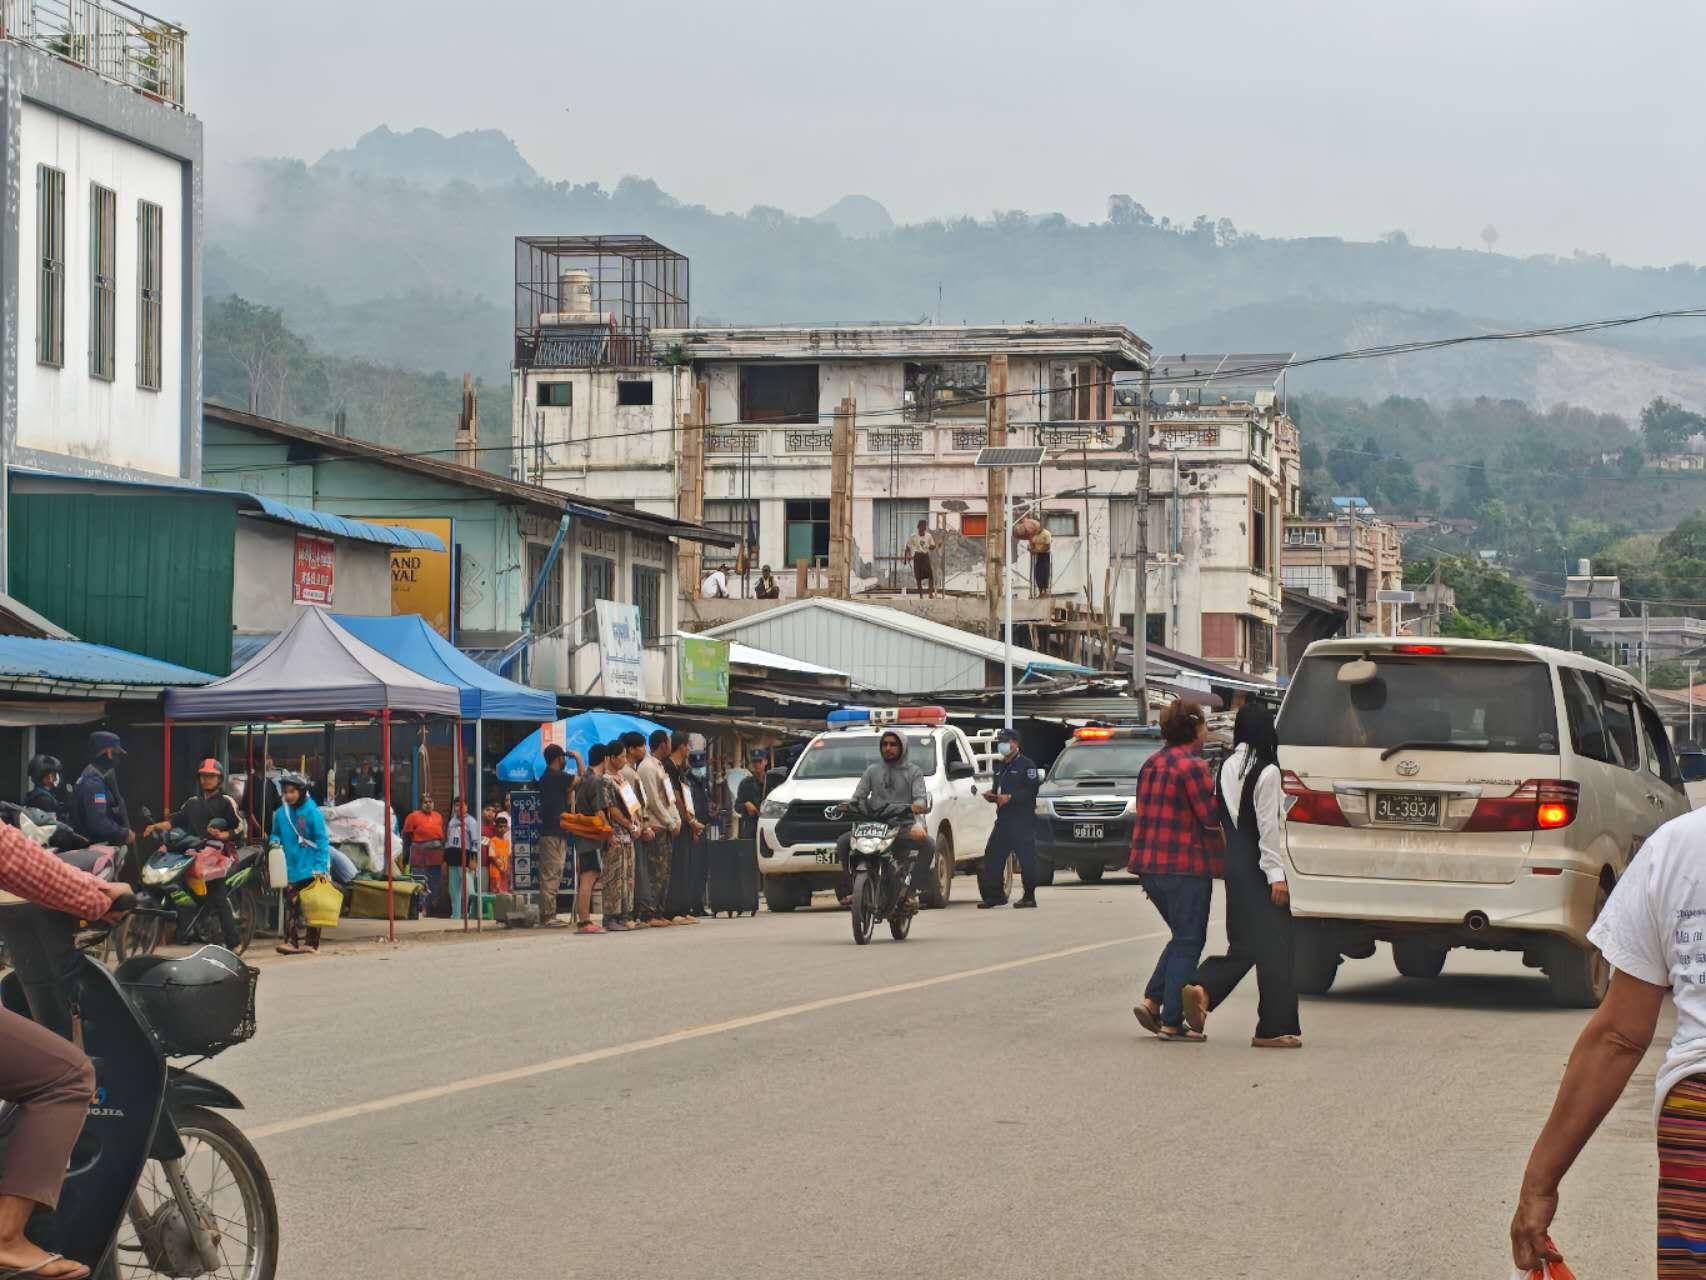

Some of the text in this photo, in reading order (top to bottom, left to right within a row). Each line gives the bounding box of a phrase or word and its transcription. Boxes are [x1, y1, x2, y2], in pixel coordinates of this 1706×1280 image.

[391, 557, 421, 569] AND
[391, 569, 417, 582] YAL
[1378, 800, 1437, 817] 3L-3934
